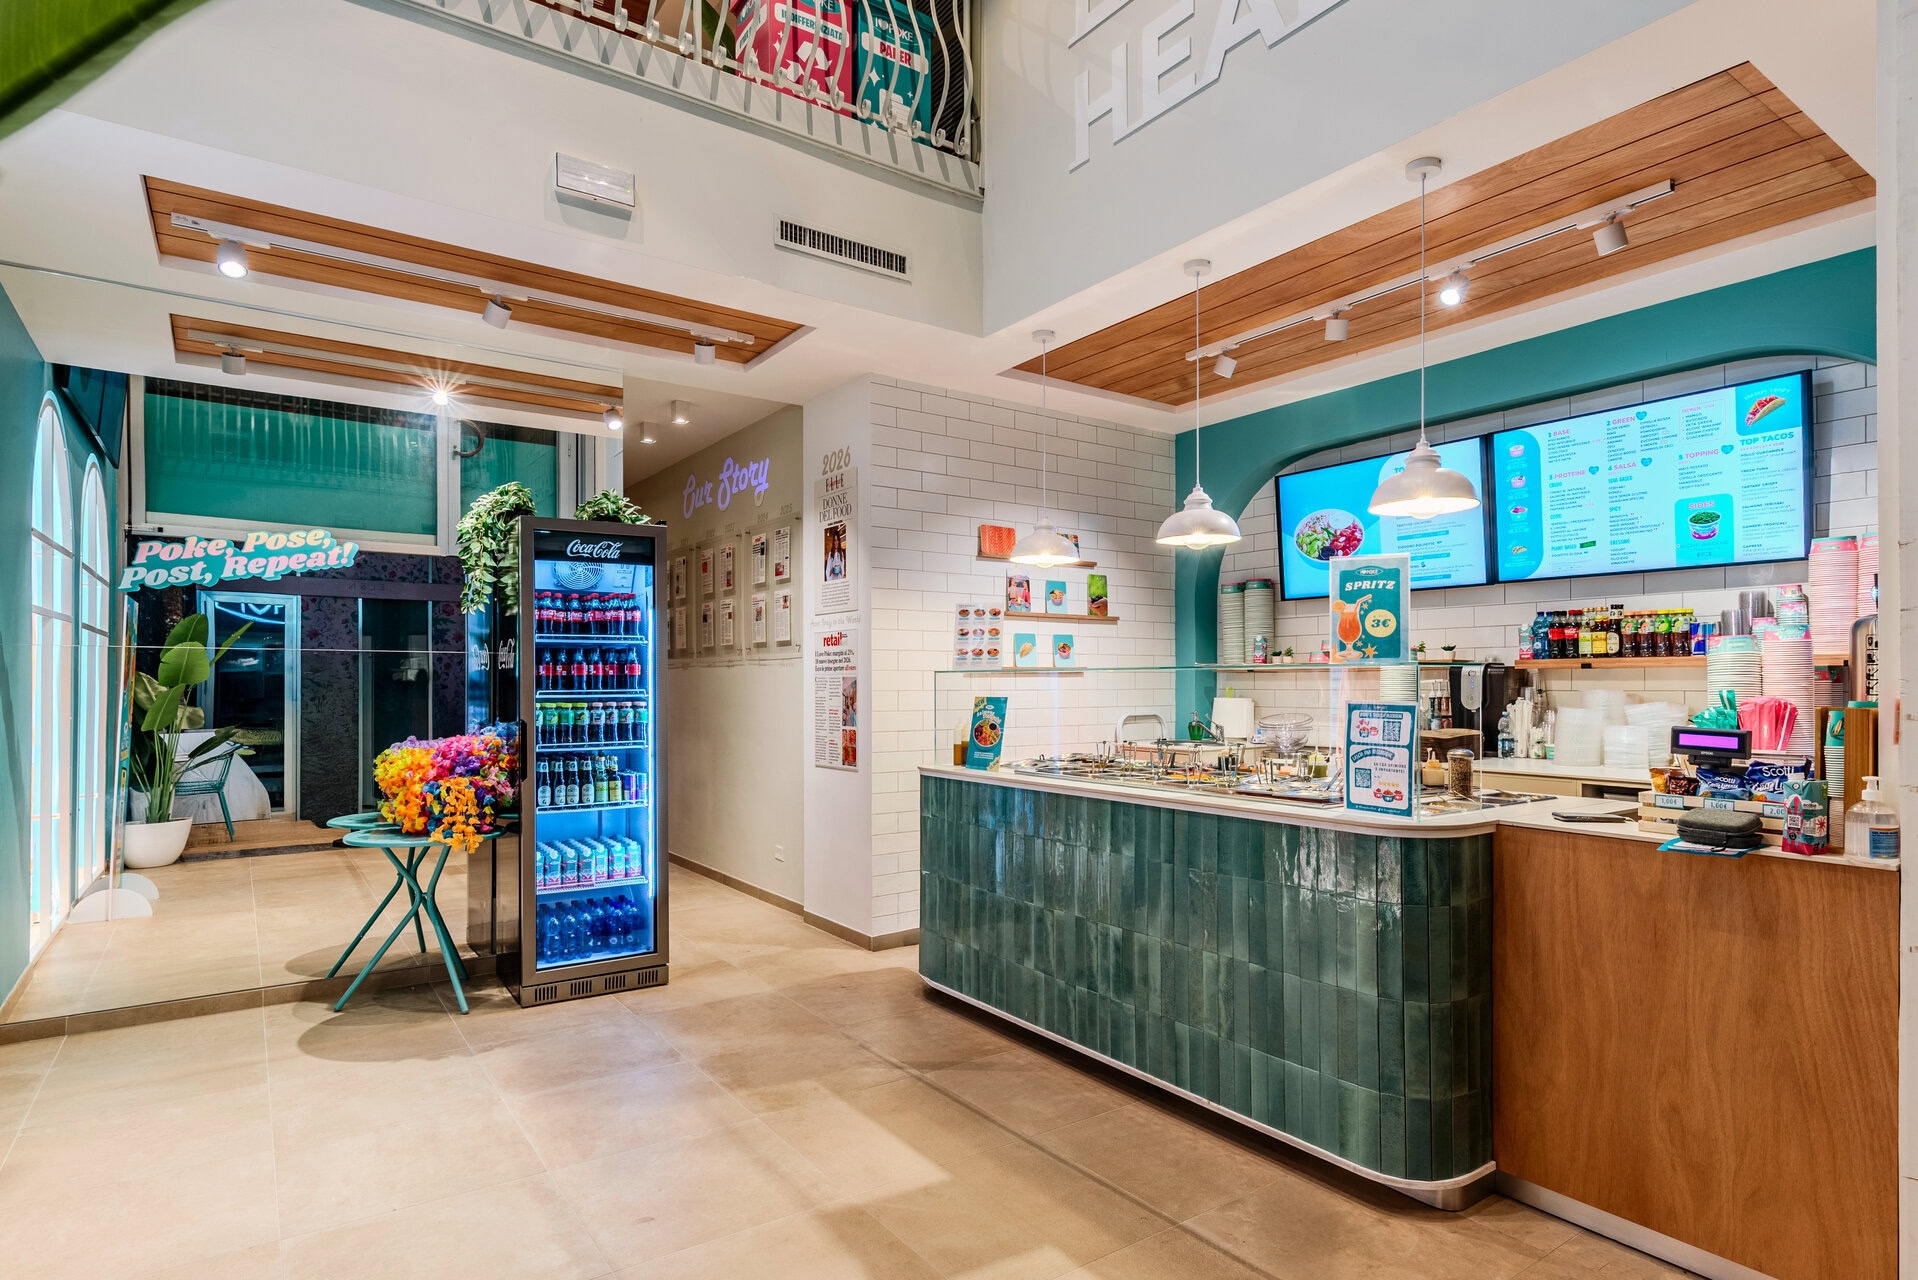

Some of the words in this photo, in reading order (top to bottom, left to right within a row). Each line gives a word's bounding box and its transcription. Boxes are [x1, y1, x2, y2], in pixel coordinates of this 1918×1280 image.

[1612, 416, 1636, 425] GREEN
[1740, 437, 1759, 446] TOP
[1761, 432, 1794, 442] TACOS
[822, 446, 851, 476] 2026
[1685, 449, 1720, 459] TOPPING
[1614, 462, 1636, 470] SALSA
[1554, 469, 1586, 479] PROTEINE
[717, 456, 770, 512] Story
[826, 473, 845, 493] ELLE
[822, 492, 848, 510] DONNE
[1689, 501, 1715, 509] SIDES
[820, 510, 832, 523] DEL
[833, 503, 852, 520] FOOD
[133, 536, 235, 564] Poke,
[242, 530, 331, 553] Pose,
[566, 538, 624, 560] Coca-Cola
[118, 564, 214, 591] Post,
[221, 543, 354, 578] Repeat!
[1344, 580, 1396, 592] SPRITZ
[1370, 618, 1392, 628] 3€
[823, 632, 842, 647] retail
[1762, 766, 1794, 777] Scotti
